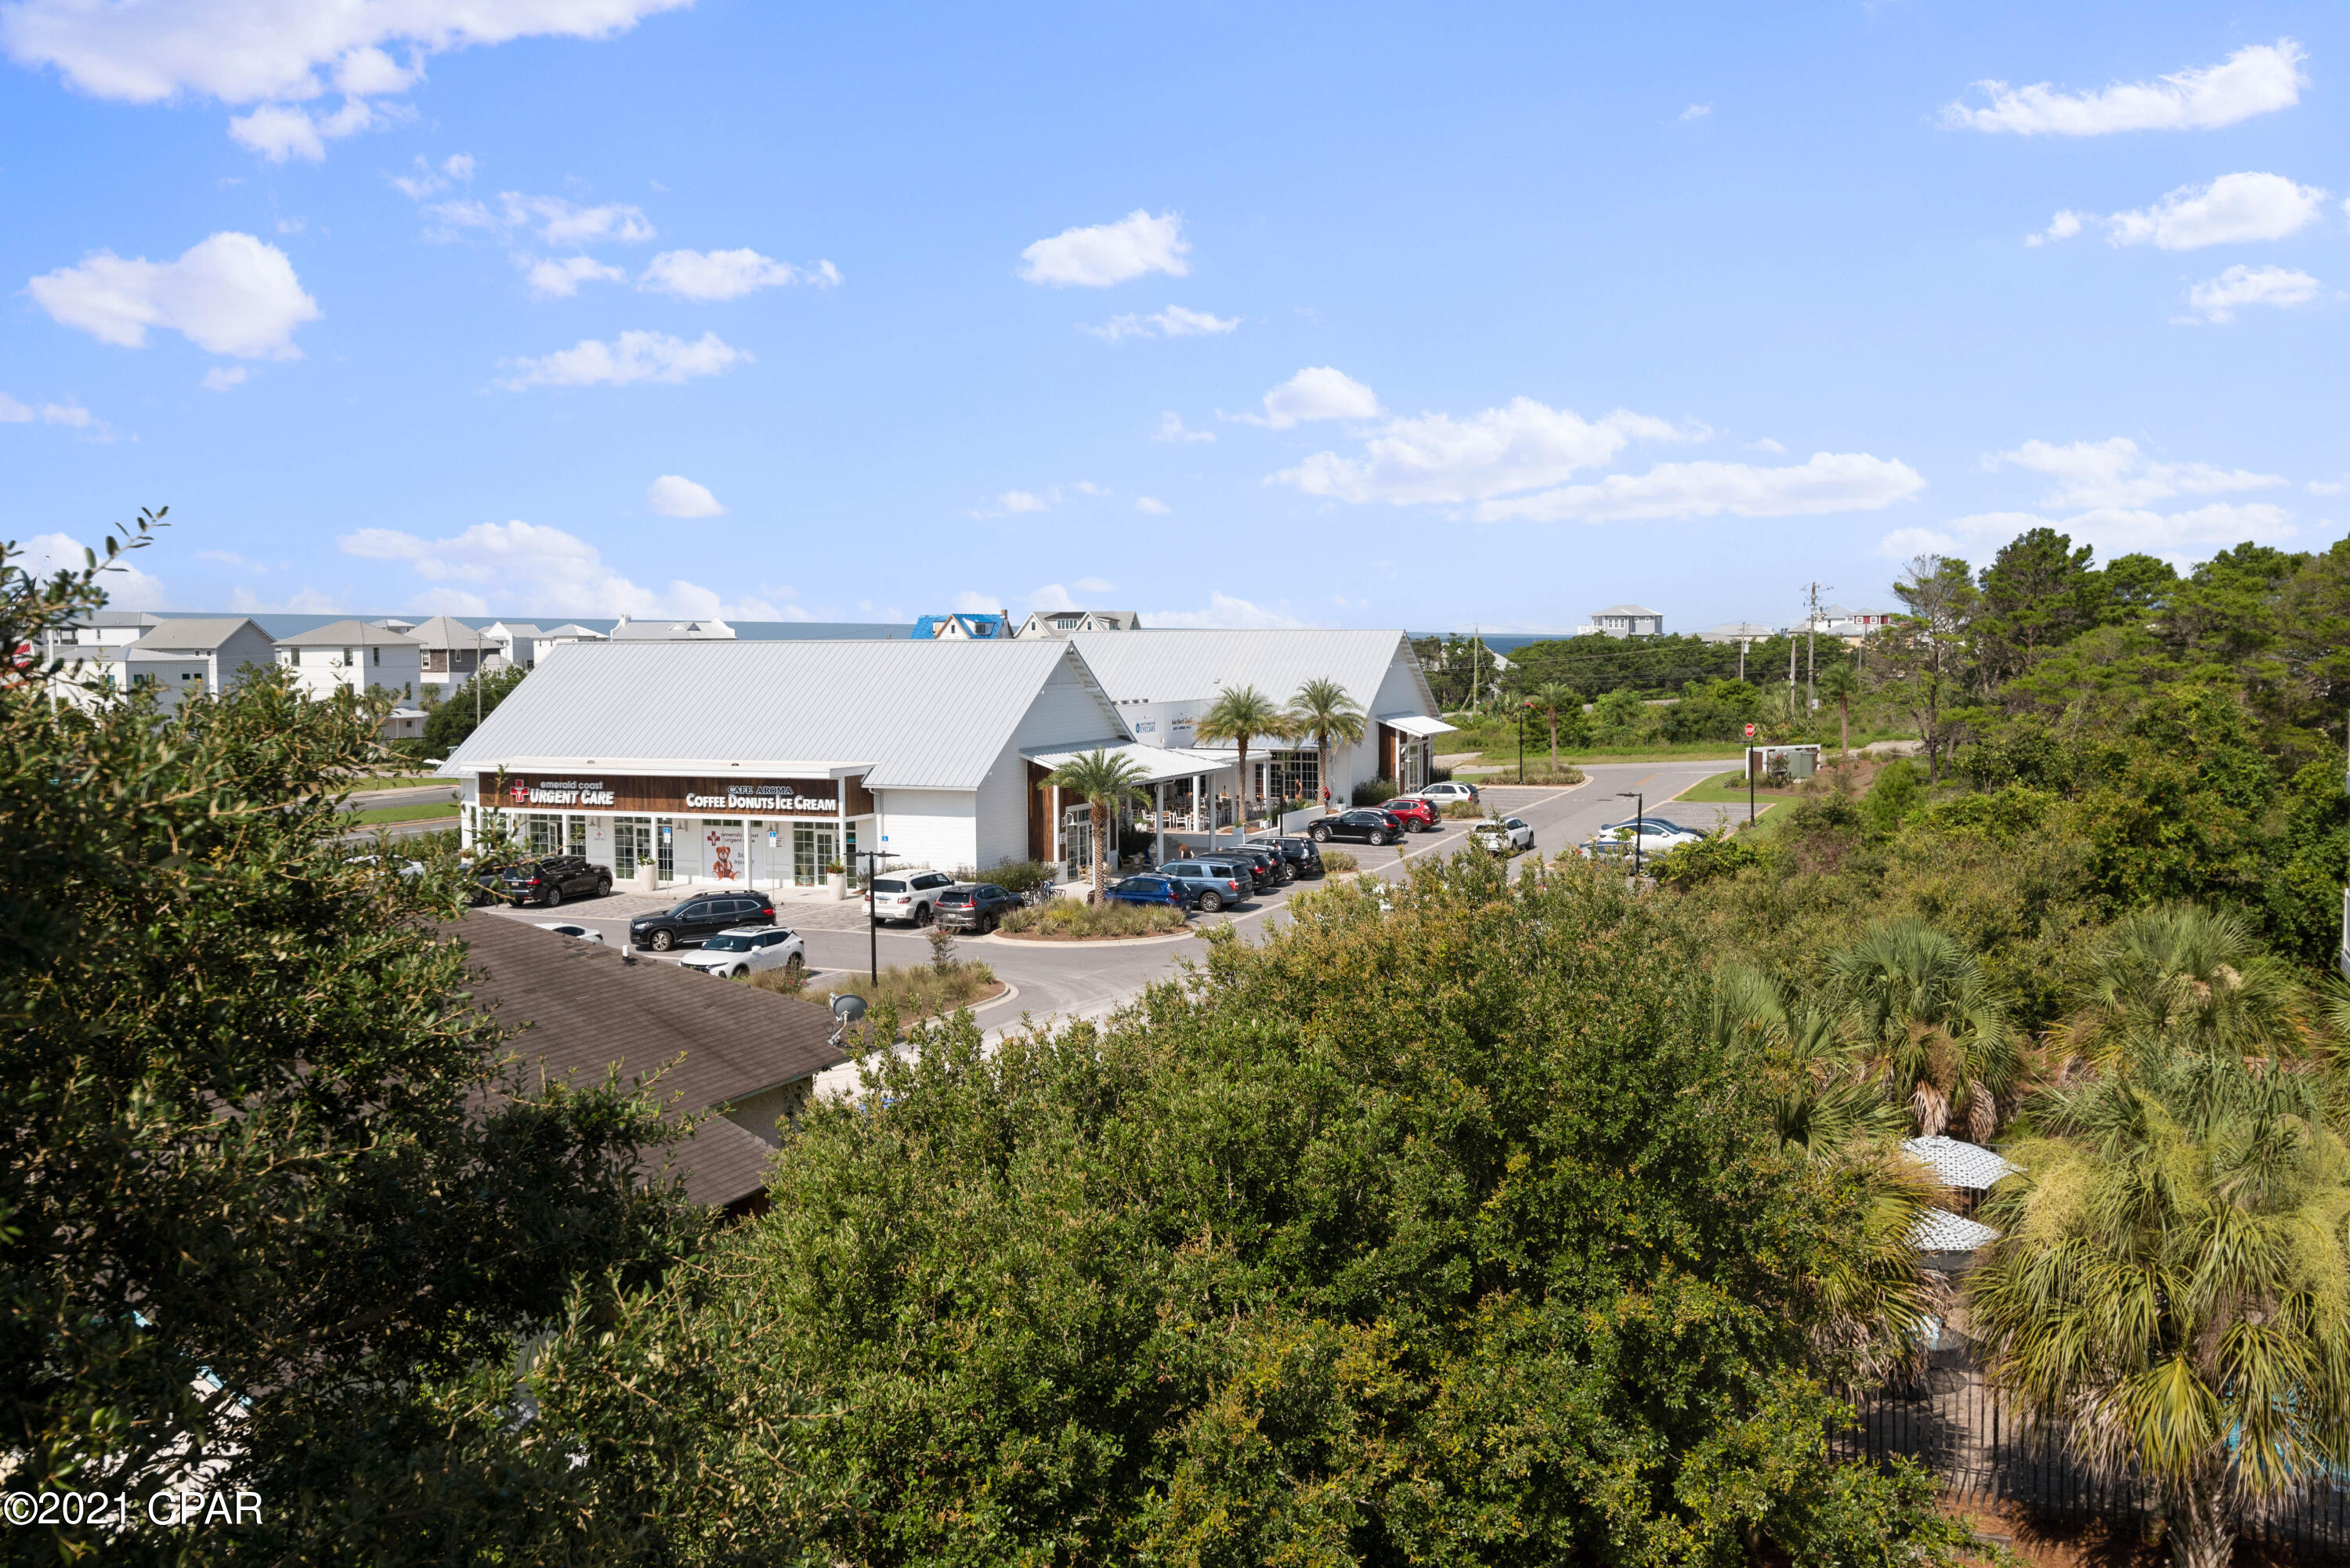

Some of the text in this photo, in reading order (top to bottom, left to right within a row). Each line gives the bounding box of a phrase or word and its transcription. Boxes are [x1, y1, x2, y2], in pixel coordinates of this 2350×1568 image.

[540, 781, 577, 789] emerald
[728, 786, 794, 796] CAFE AROMA
[530, 789, 615, 805] URGENT CARE
[686, 793, 837, 811] COFFEE DONUTS ICE CREAM
